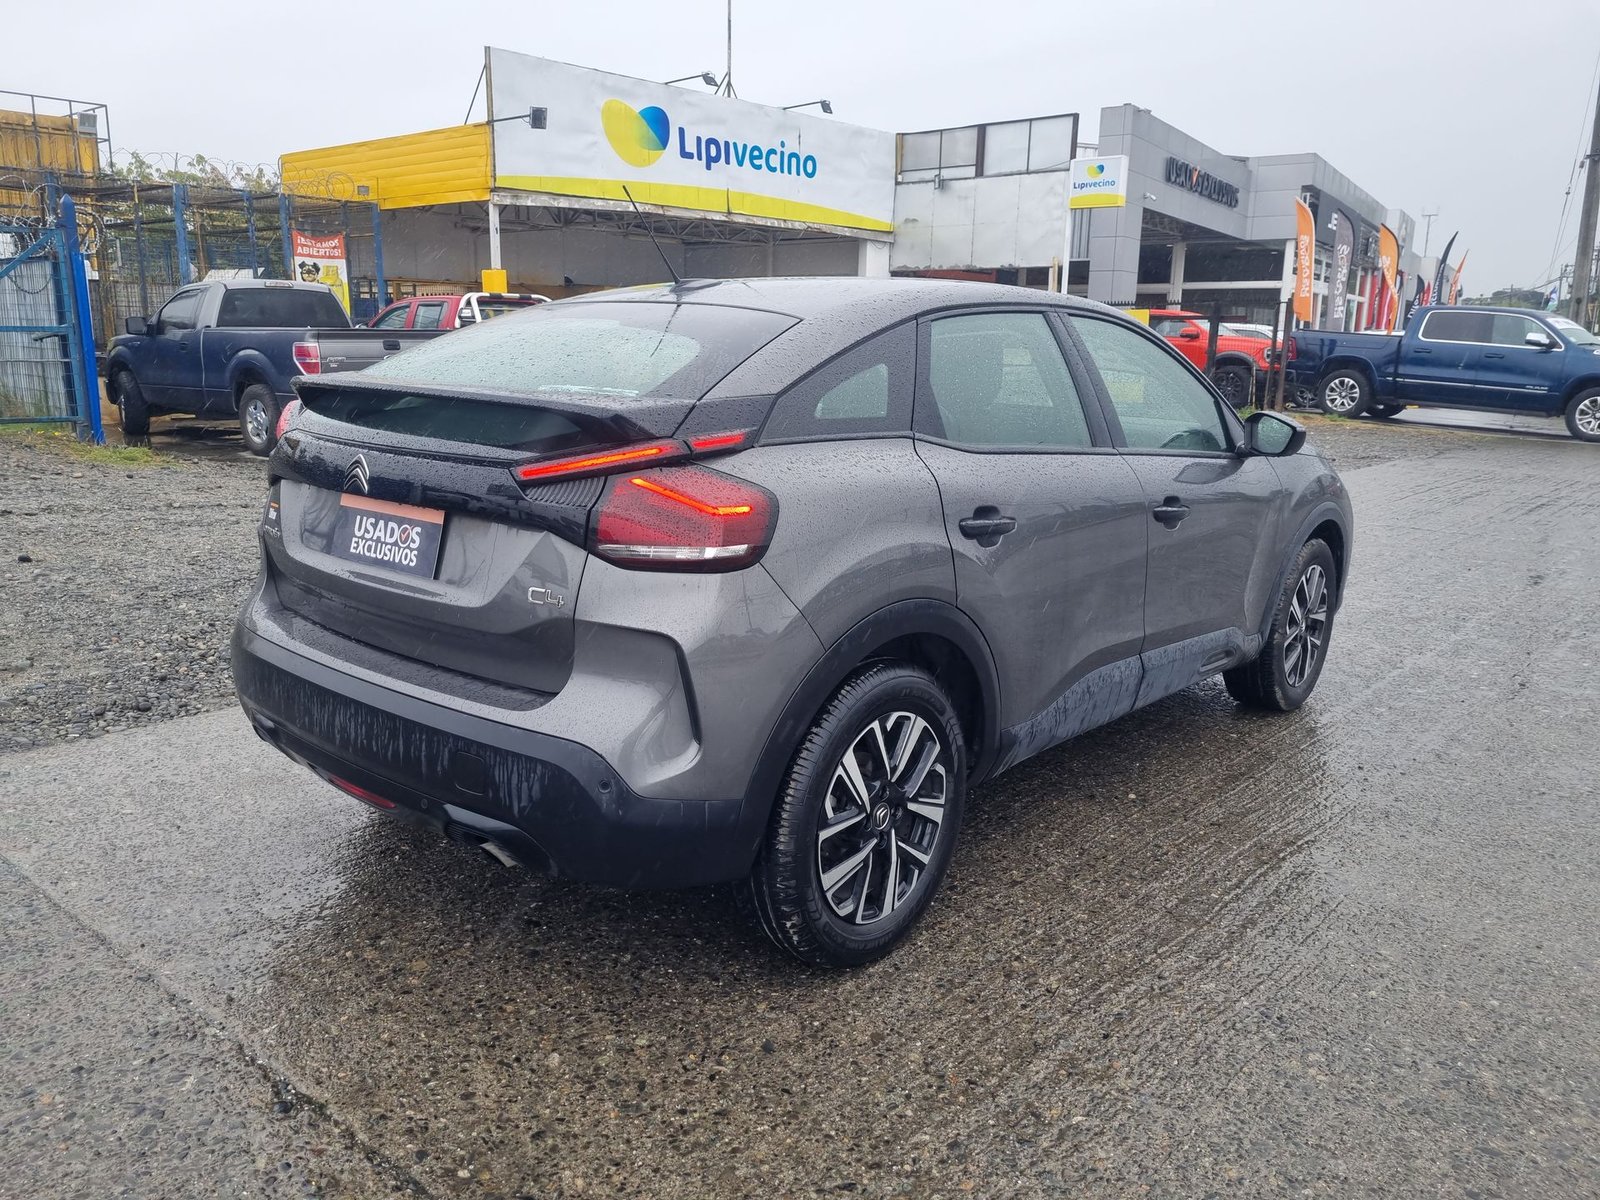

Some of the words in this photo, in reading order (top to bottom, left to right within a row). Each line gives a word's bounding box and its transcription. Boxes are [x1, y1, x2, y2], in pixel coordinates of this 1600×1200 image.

[678, 127, 817, 178] Lipivecino
[1073, 179, 1116, 190] Lipivecino
[296, 246, 342, 256] ABIERTOS!
[354, 515, 422, 549] USADOS
[350, 537, 418, 567] EXCLUSIVOS
[527, 586, 565, 608] C4
